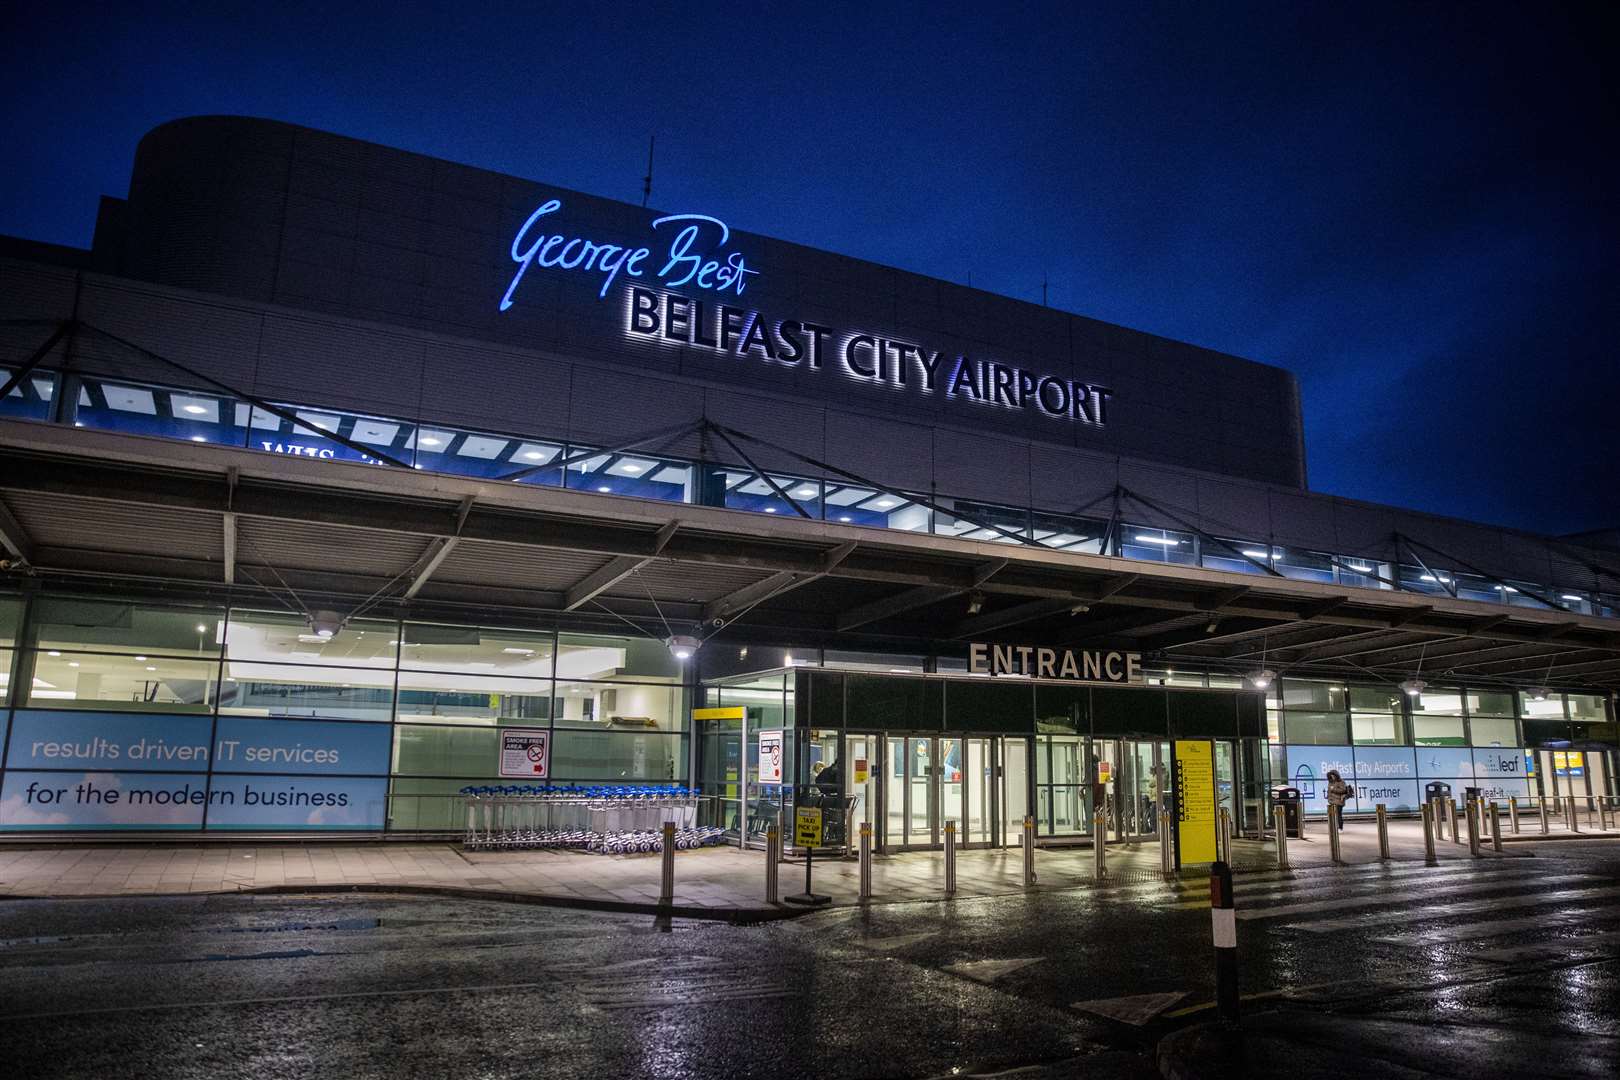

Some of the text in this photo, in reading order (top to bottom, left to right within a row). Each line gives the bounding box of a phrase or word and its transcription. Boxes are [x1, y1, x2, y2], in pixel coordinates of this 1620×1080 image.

[500, 200, 760, 311] George Best
[629, 287, 1114, 424] BELFAST CITY AIRPORT
[969, 642, 1145, 682] ENTRANCE
[31, 737, 340, 764] results driven IT services
[1321, 761, 1353, 774] Belfast
[1356, 760, 1373, 777] City
[1498, 755, 1519, 772] leaf
[26, 782, 68, 805] for
[76, 782, 120, 805] the
[129, 784, 235, 805] modern
[1358, 786, 1368, 799] IT
[1369, 786, 1401, 802] partner
[802, 817, 816, 825] TAXI
